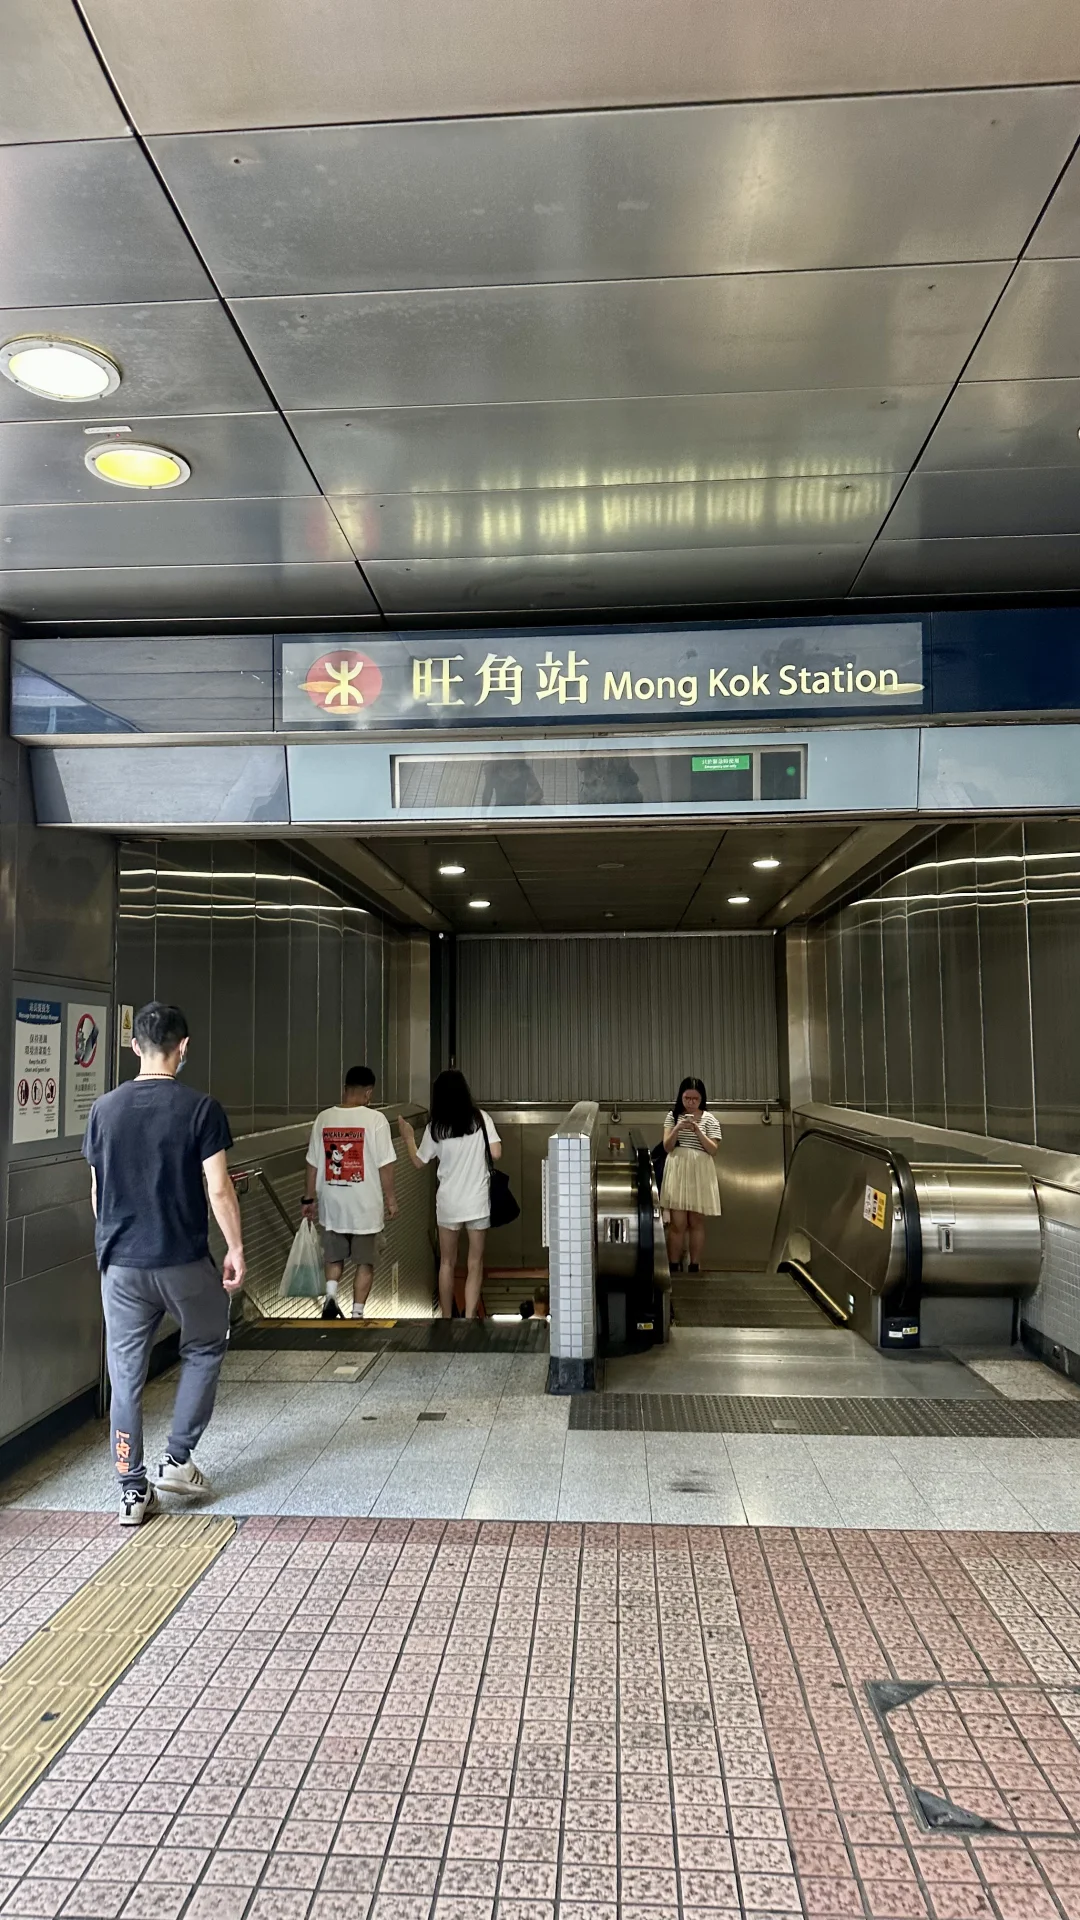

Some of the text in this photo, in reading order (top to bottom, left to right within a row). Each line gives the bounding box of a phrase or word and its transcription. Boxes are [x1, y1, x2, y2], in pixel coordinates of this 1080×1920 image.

[412, 651, 590, 708] 旺角站
[603, 662, 900, 706] Mong Kok Station
